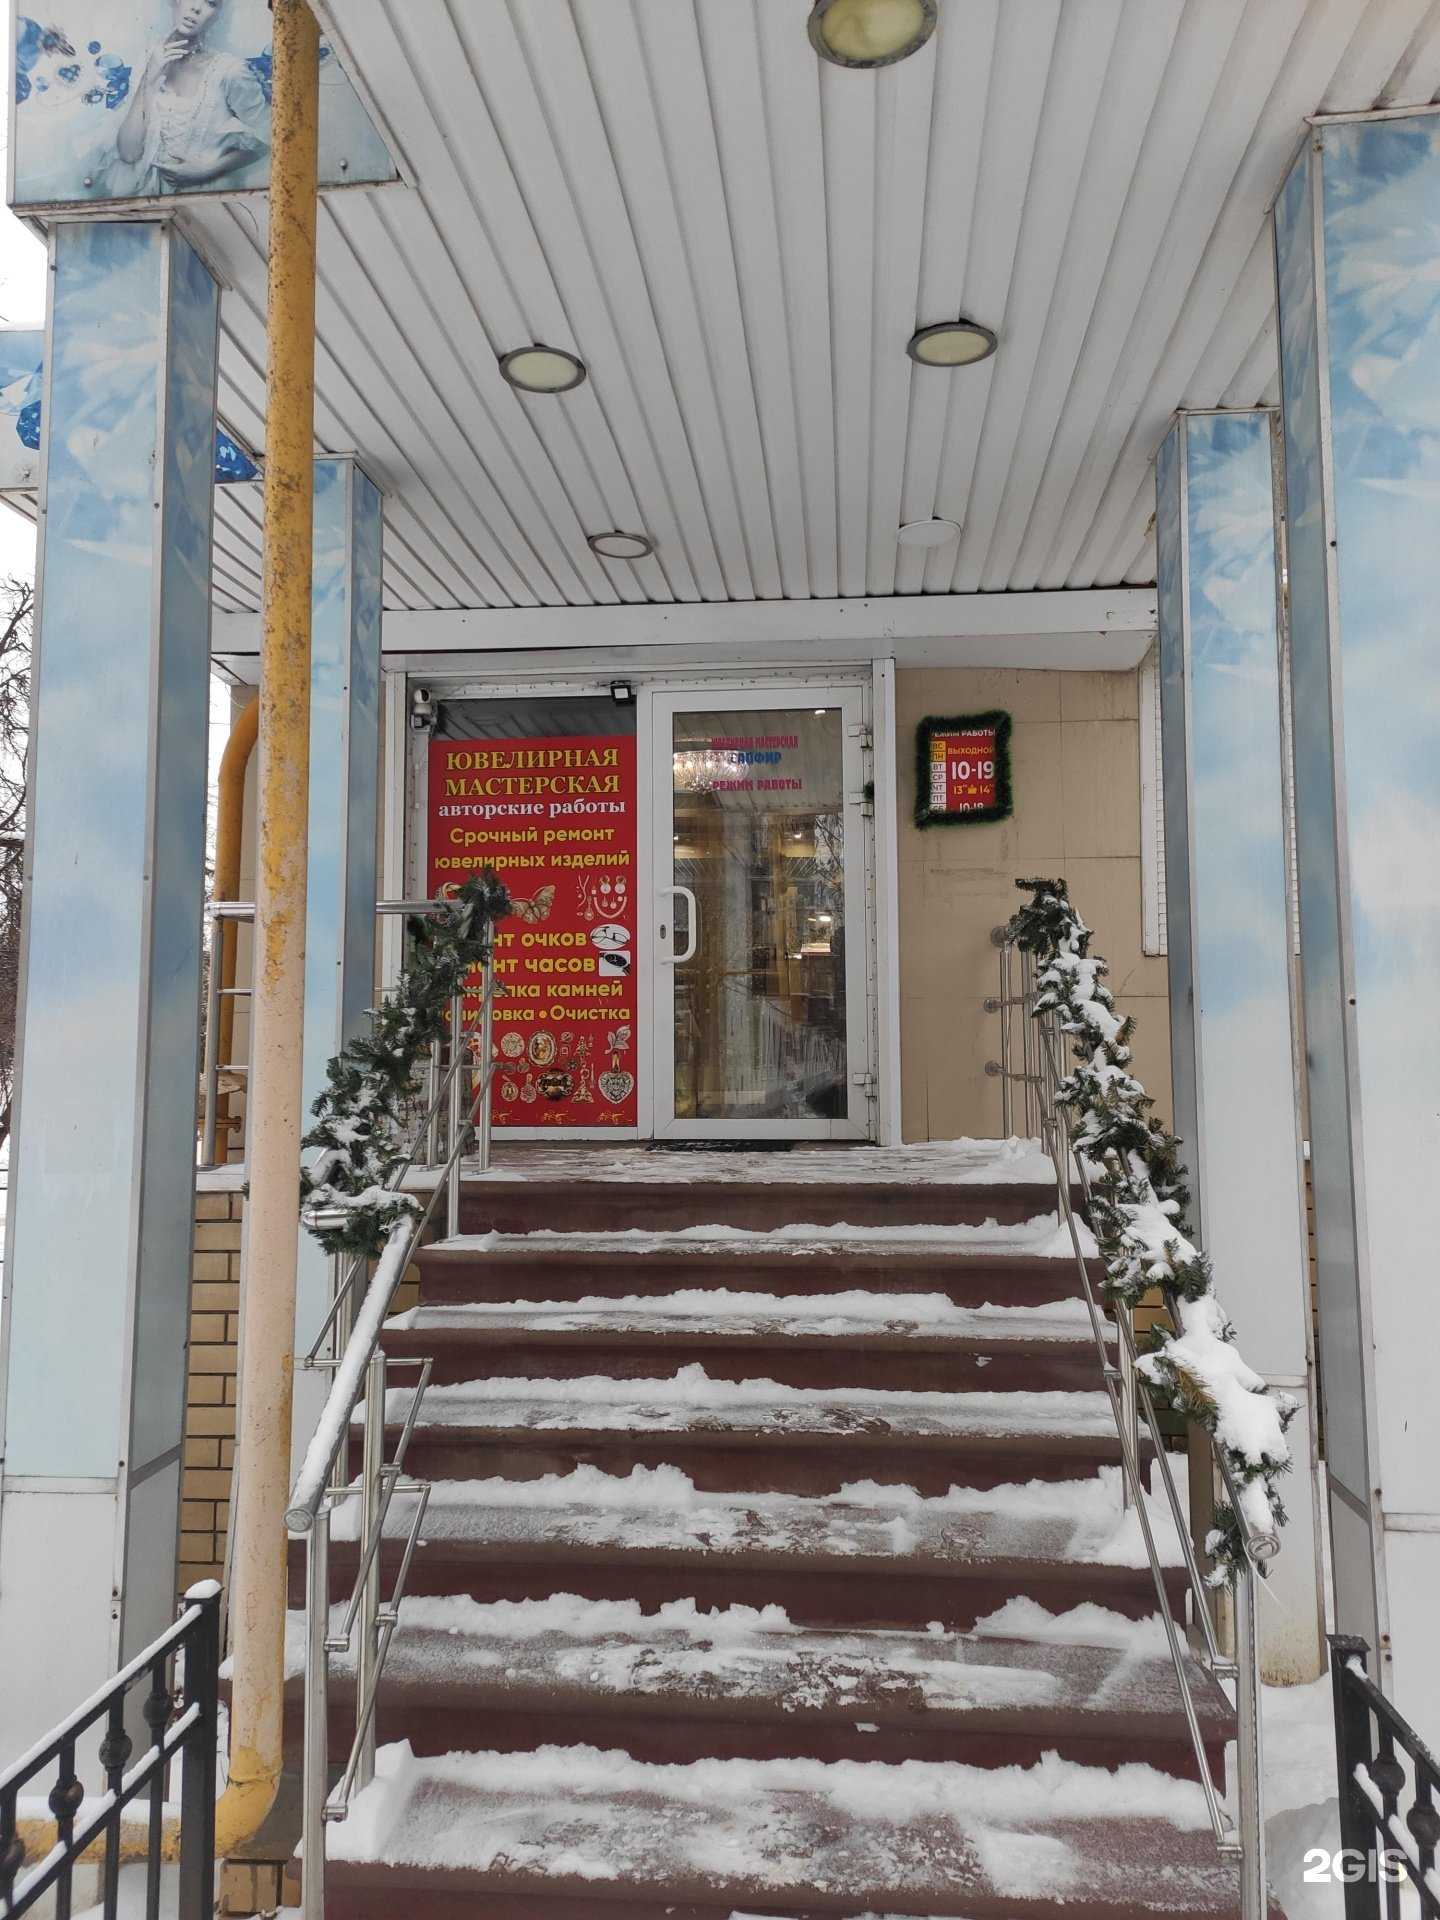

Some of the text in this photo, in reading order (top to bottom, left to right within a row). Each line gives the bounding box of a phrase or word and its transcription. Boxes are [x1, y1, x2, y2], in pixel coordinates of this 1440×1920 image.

[446, 748, 619, 770] ЮВЕЛИРНАЯ
[951, 761, 995, 780] 10-19
[446, 775, 620, 796] МАСТЕРСКАЯ
[757, 779, 802, 790] РАБОТЫ
[438, 798, 626, 819] авторские работы
[450, 826, 615, 847] Срочный ремонт
[434, 850, 630, 871] ювелирных изделий
[521, 932, 587, 947] очков
[524, 957, 595, 973] часов
[547, 979, 623, 997] камней
[550, 1005, 630, 1020] Очистка
